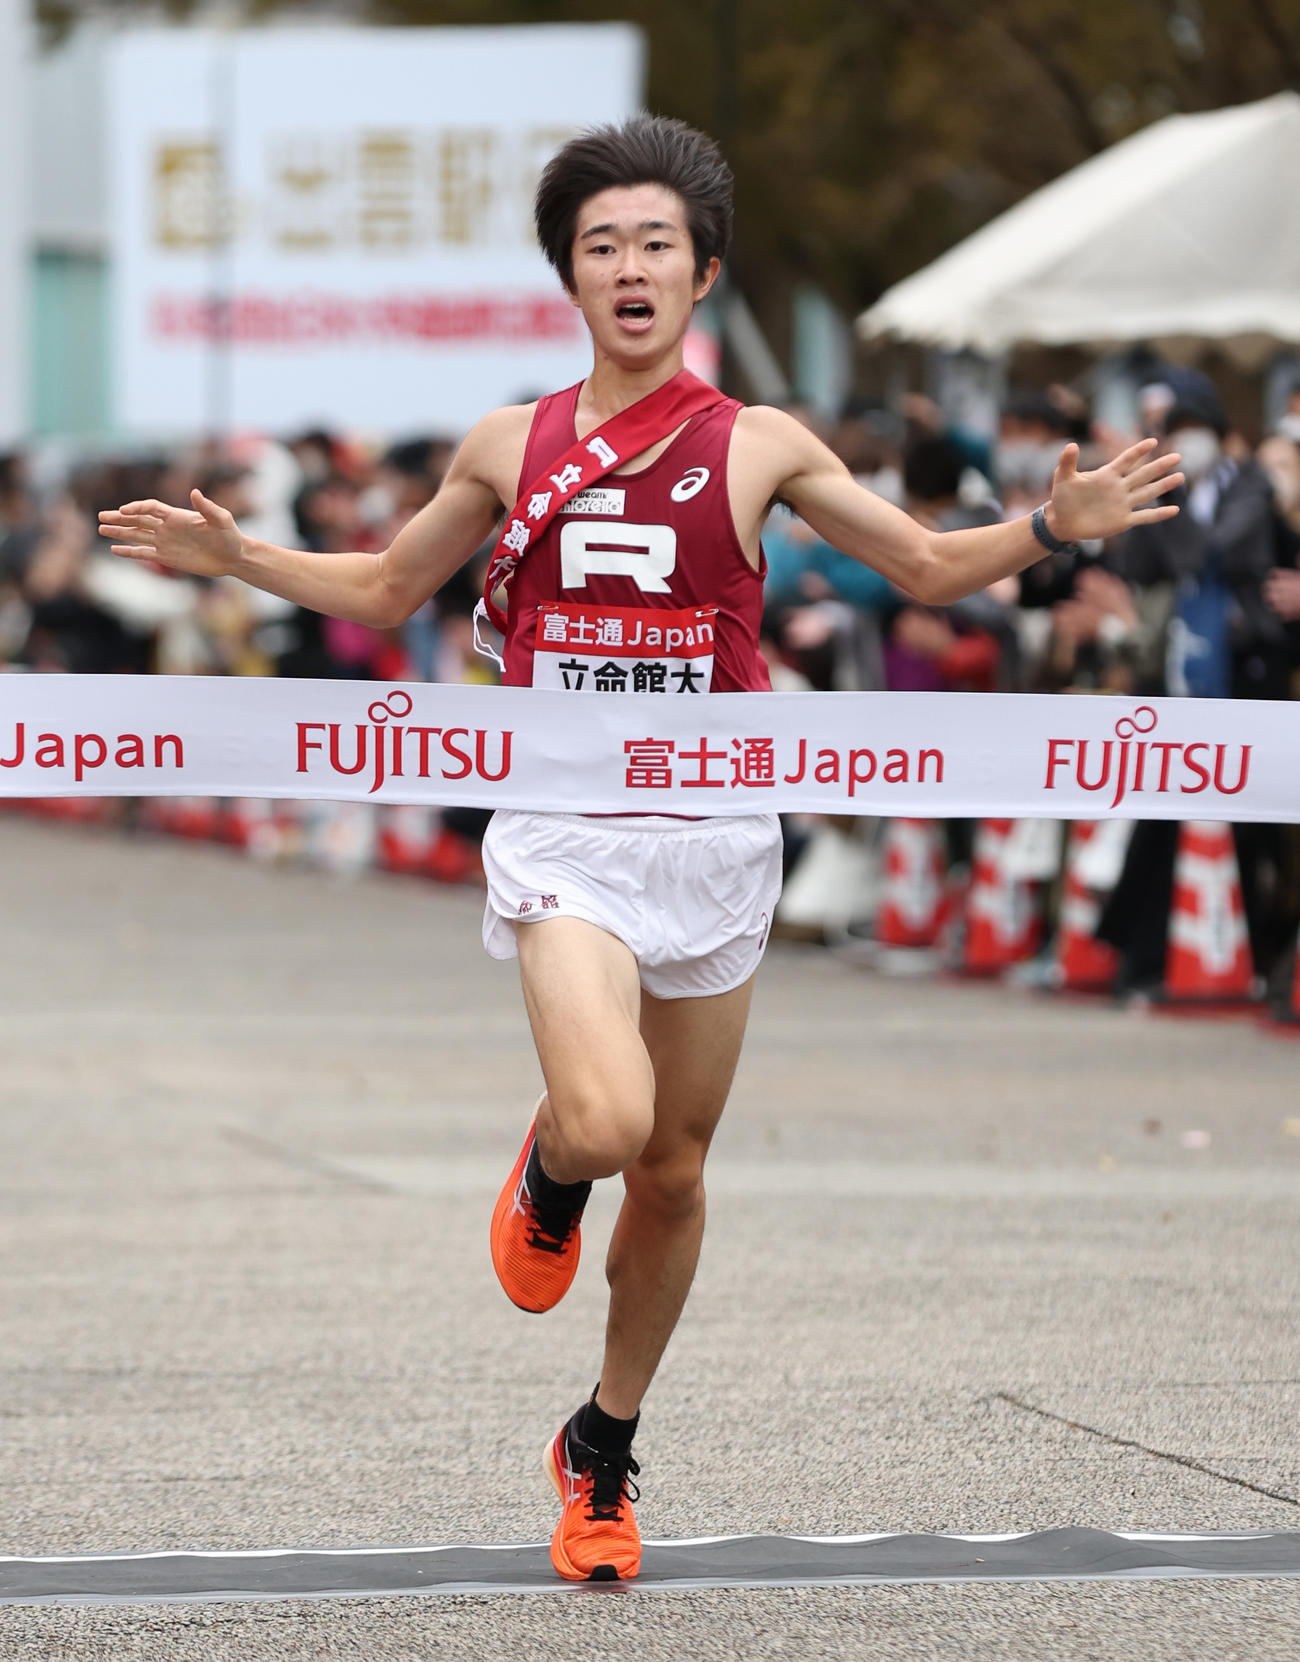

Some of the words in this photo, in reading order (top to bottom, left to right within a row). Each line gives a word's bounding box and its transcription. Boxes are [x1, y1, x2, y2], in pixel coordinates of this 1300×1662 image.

[560, 520, 677, 594] R
[543, 612, 714, 653] 富士通Japan
[0, 722, 184, 781] Japan
[297, 690, 513, 793] FUJITSU
[624, 737, 943, 797] 富士通Japan
[1045, 706, 1250, 808] FUJITSU
